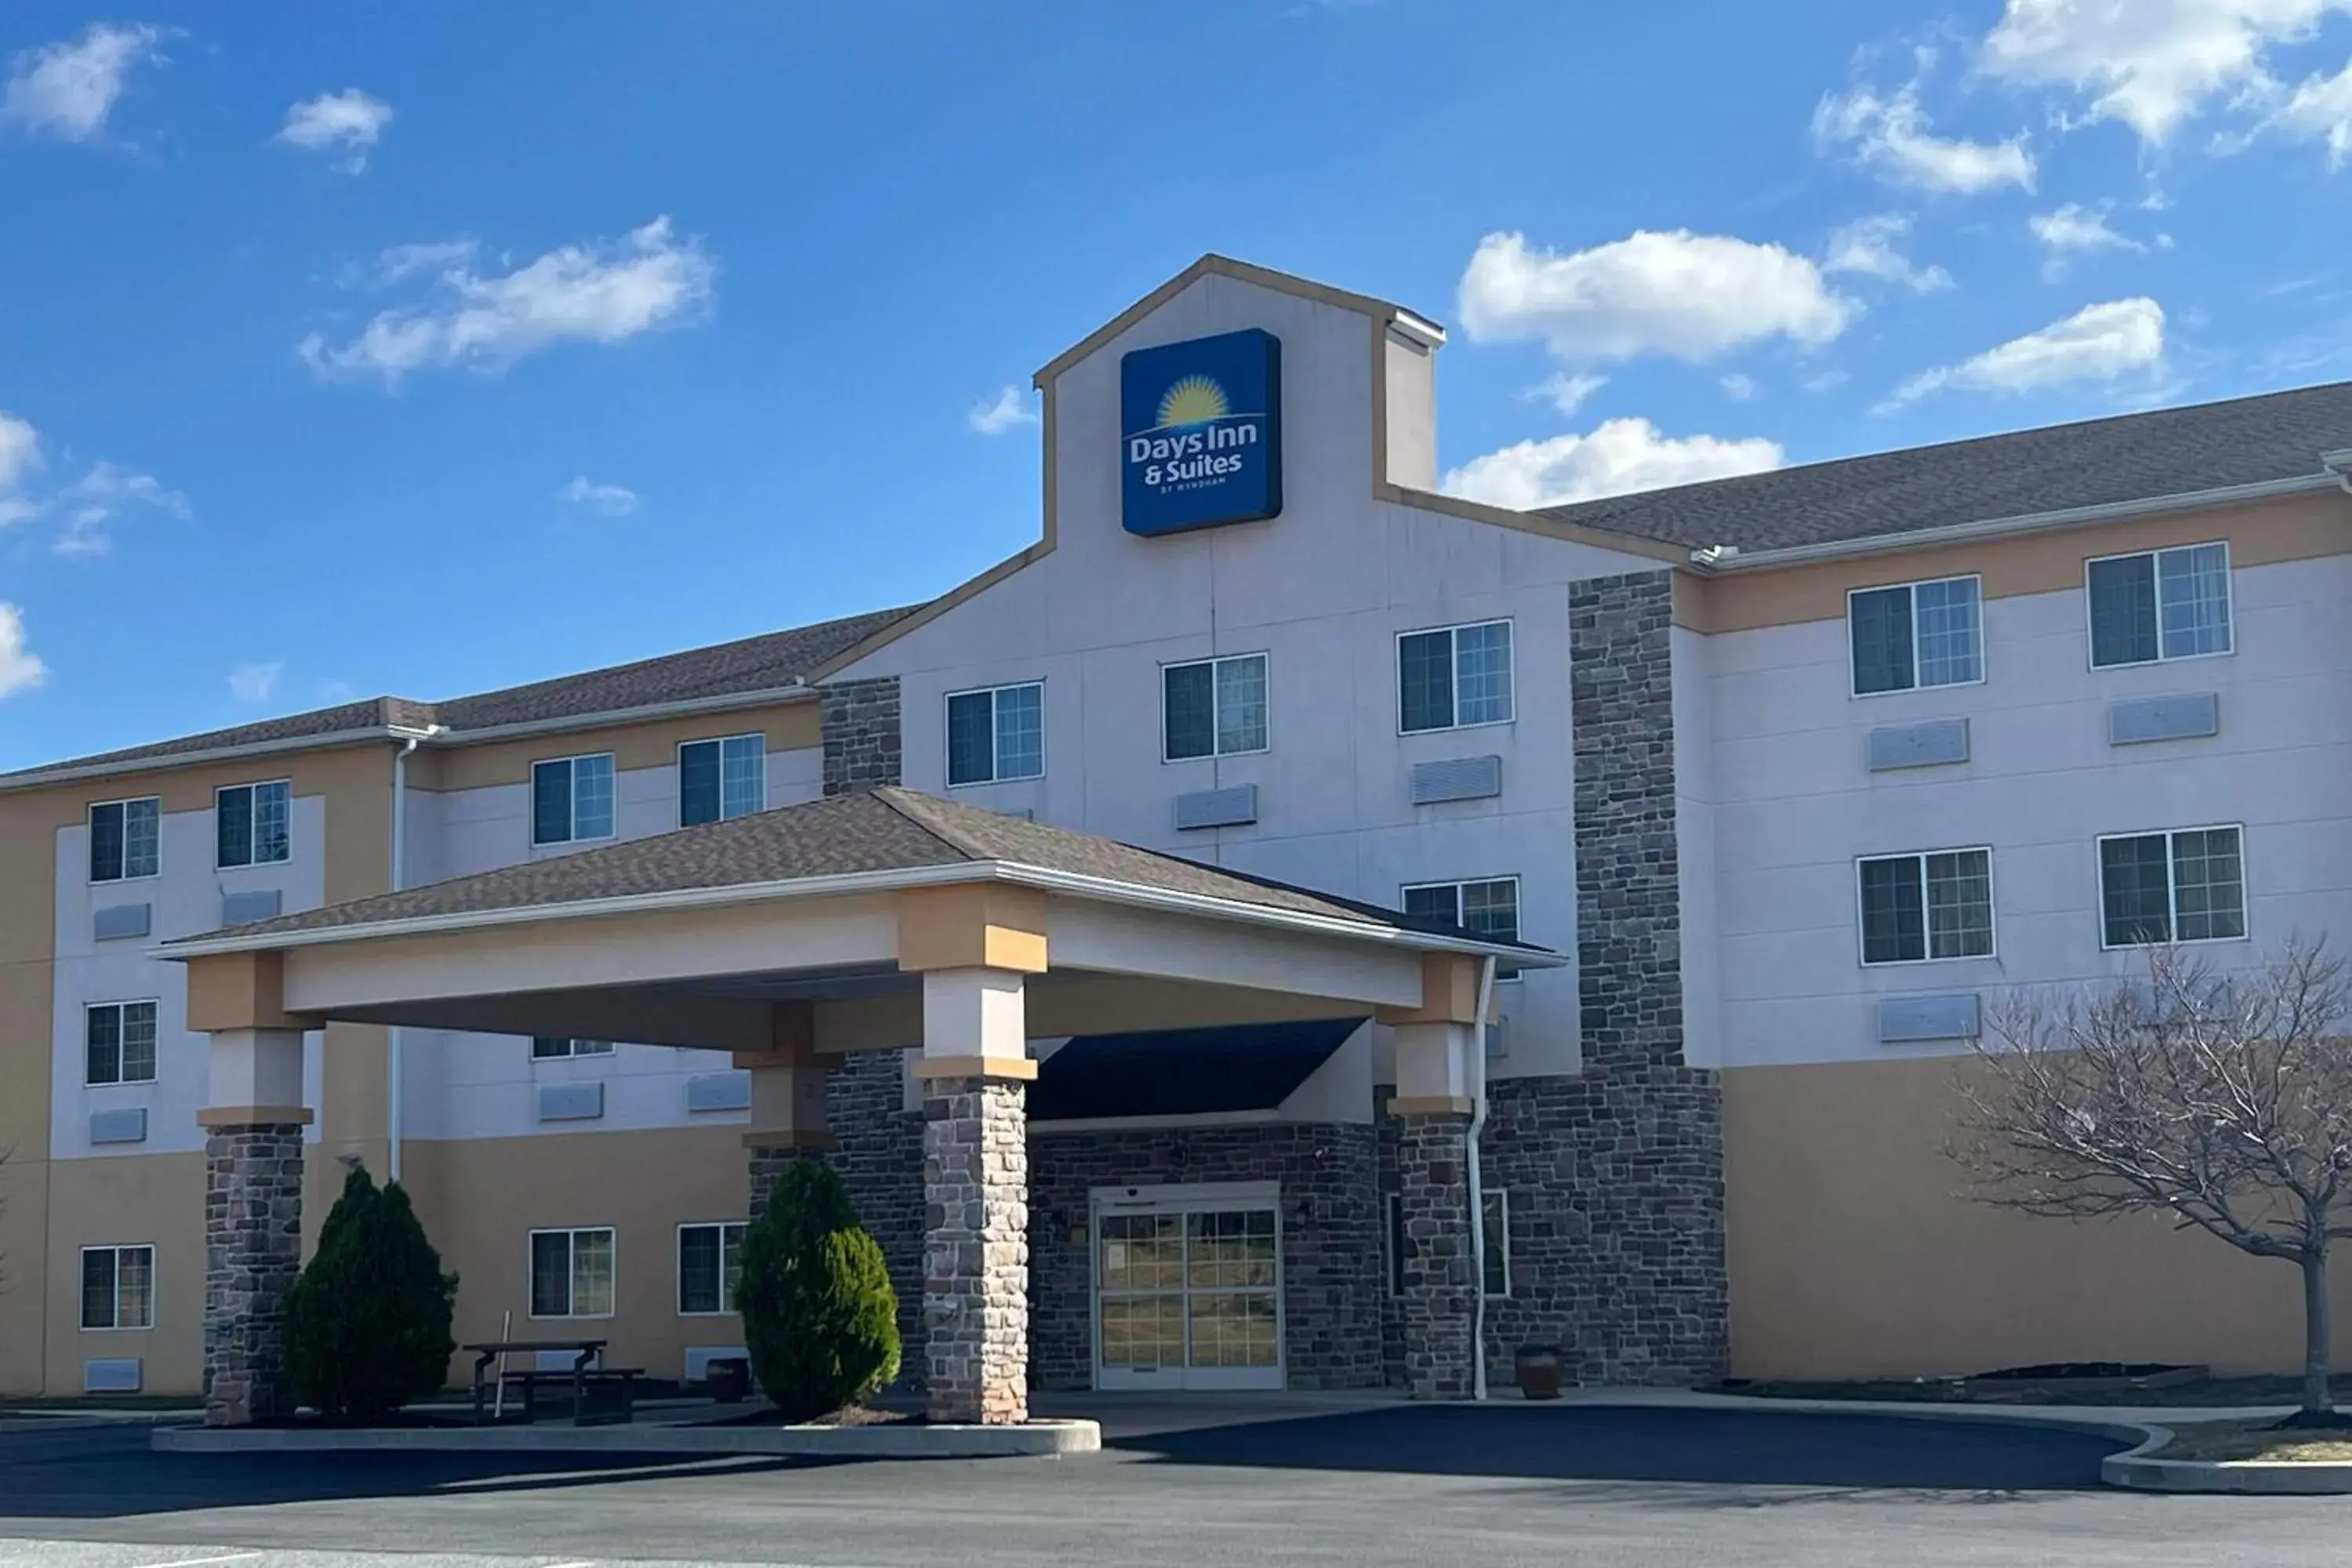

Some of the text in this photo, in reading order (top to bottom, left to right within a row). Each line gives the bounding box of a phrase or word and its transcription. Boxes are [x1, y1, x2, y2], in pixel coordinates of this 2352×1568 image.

[1131, 424, 1257, 463] Days Inn
[1145, 454, 1242, 485] & Suites
[1178, 477, 1225, 491] WYNDHAM
